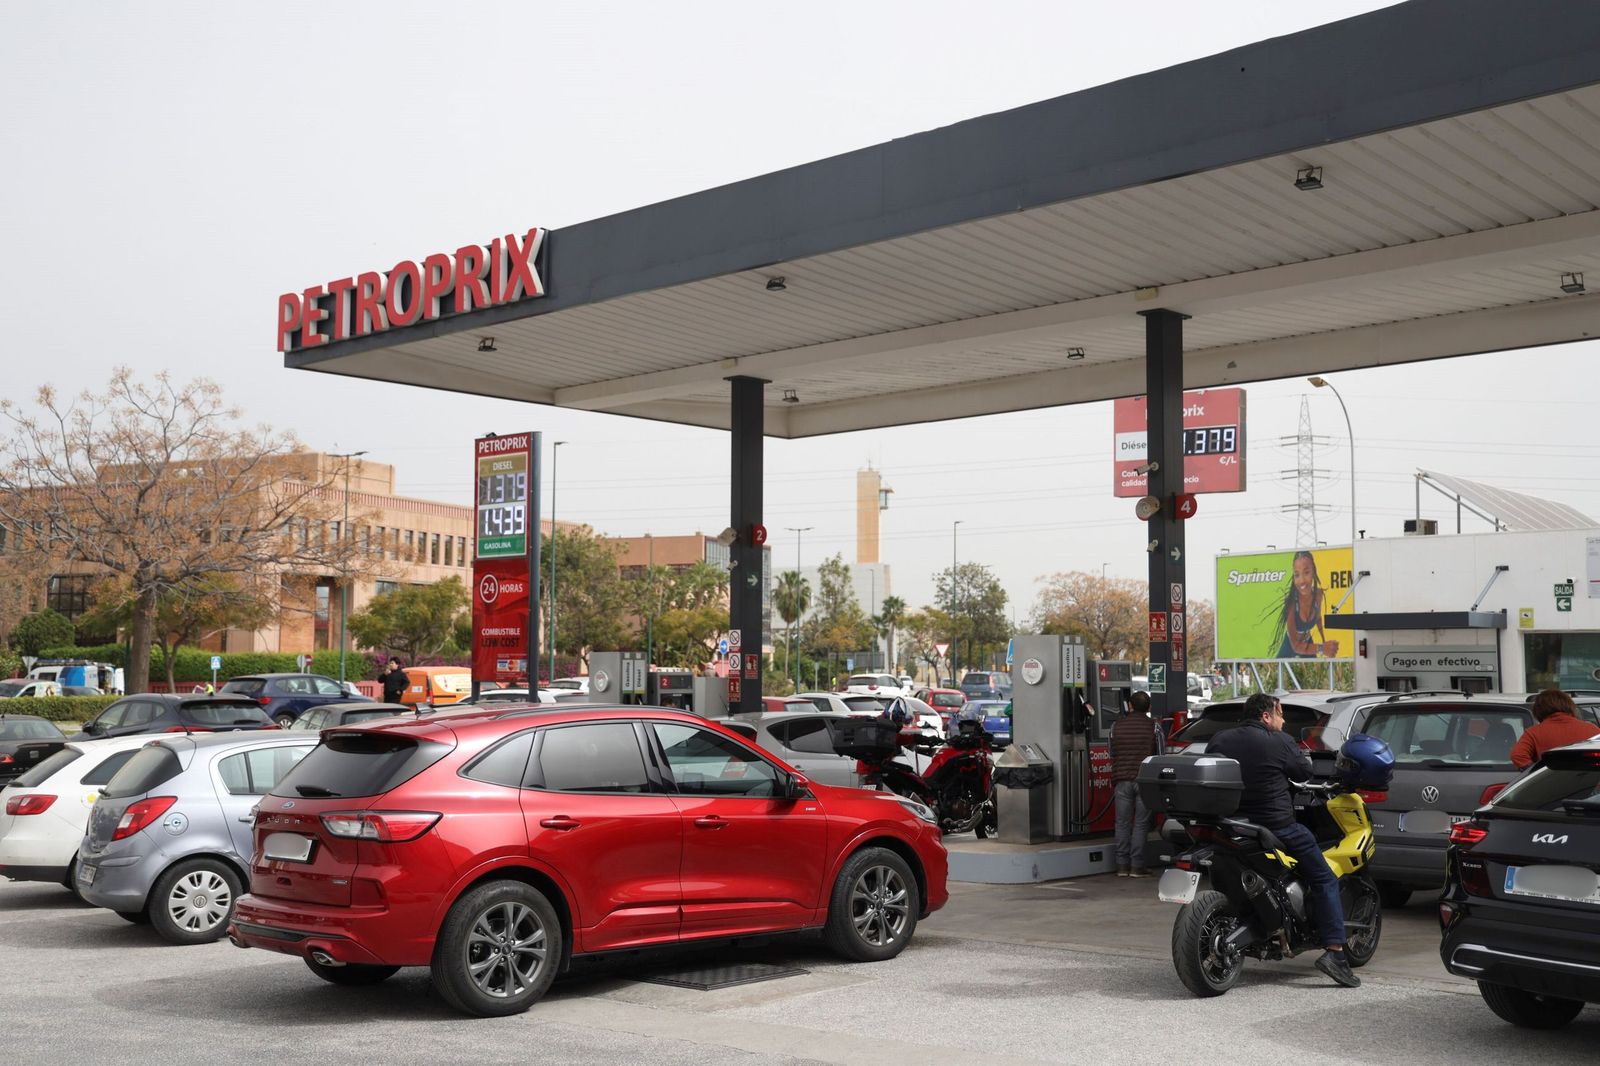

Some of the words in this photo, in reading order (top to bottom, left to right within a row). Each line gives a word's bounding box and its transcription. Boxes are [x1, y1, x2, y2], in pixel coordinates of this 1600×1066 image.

[277, 227, 545, 352] PETROPRIX
[478, 436, 528, 453] PETROPRIX
[1121, 440, 1147, 451] Diése
[1183, 428, 1235, 454] 1.379
[492, 460, 513, 471] DIESEL
[1184, 475, 1200, 484] ecio
[487, 473, 527, 502] 1.379
[1180, 500, 1191, 514] 4
[484, 505, 525, 535] 1.439
[756, 530, 763, 541] 2
[484, 541, 511, 550] GASOLINA
[1227, 568, 1287, 586] Sprinter
[483, 581, 496, 594] 24
[499, 583, 523, 593] HORAS
[481, 627, 521, 636] COMBUSTIBLE
[1392, 657, 1418, 668] Pago
[1419, 658, 1432, 666] en
[1437, 656, 1480, 666] efectivo
[1101, 668, 1106, 678] 4
[662, 678, 668, 687] 2
